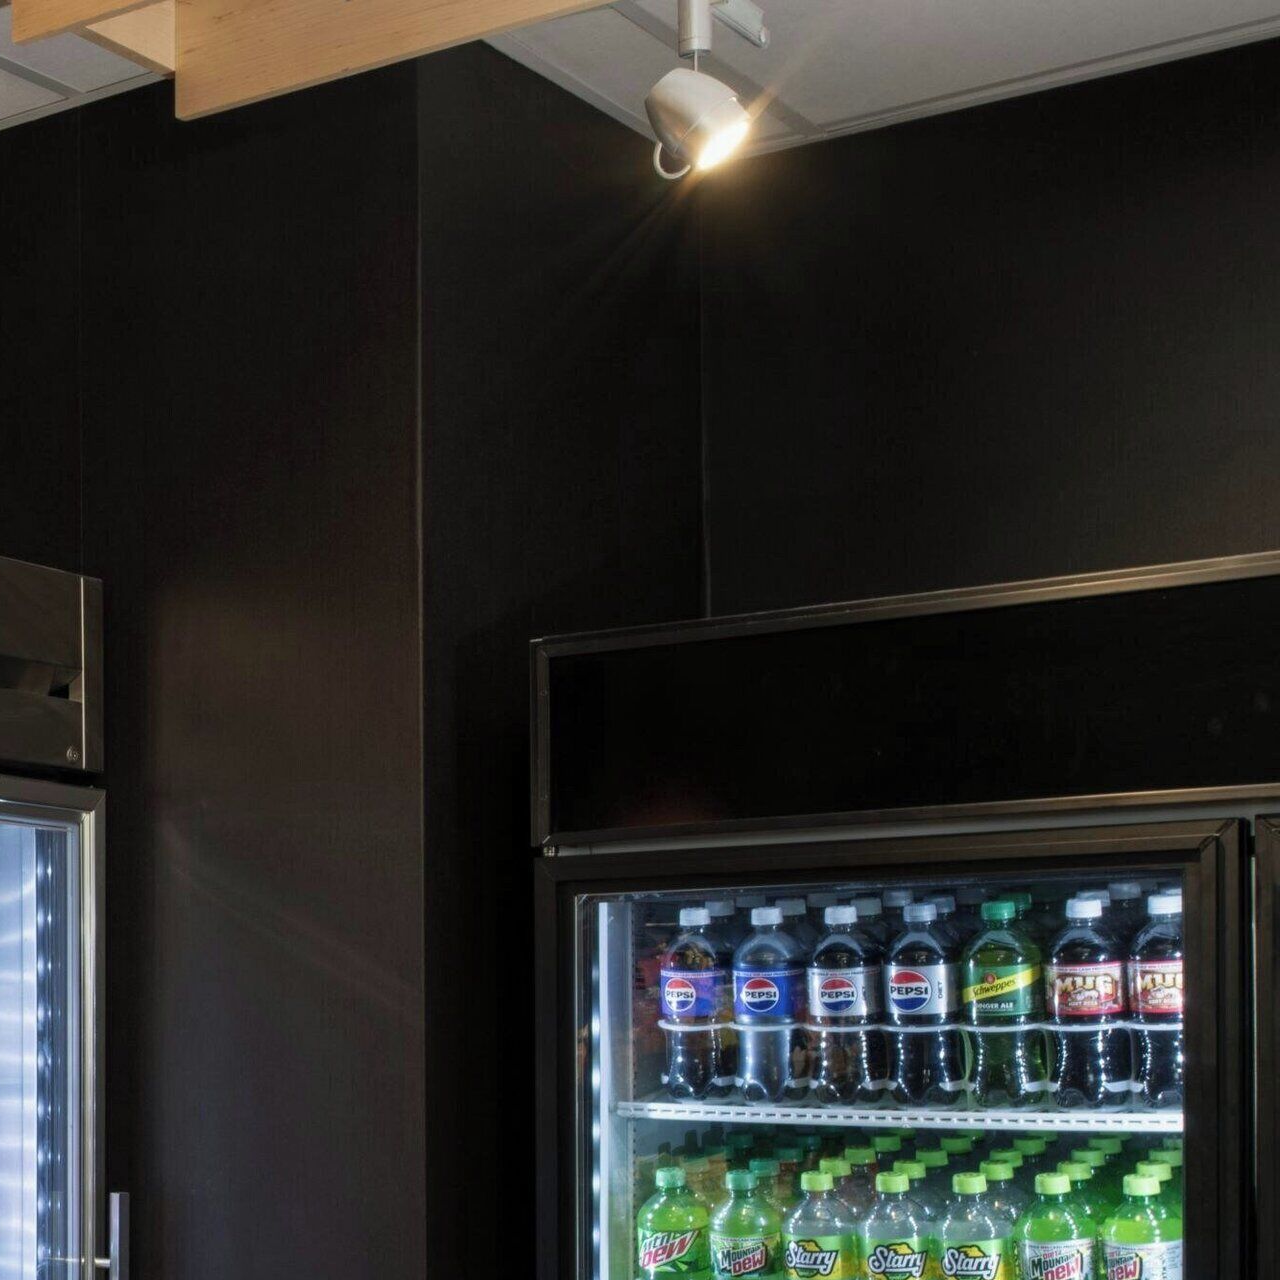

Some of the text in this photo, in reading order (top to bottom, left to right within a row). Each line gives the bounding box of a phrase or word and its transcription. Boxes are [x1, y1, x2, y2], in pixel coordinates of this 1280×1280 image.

[890, 986, 928, 995] PEPSI
[972, 979, 1016, 996] Schweppes
[1058, 974, 1114, 993] MUG
[665, 990, 694, 999] PEPSI
[745, 990, 777, 999] PEPSI
[820, 990, 855, 999] PEPSI
[1000, 1001, 1014, 1009] ALE
[732, 1246, 765, 1276] DEW
[786, 1242, 838, 1277] Starry
[868, 1244, 925, 1279] Starry
[943, 1247, 1000, 1280] Starry
